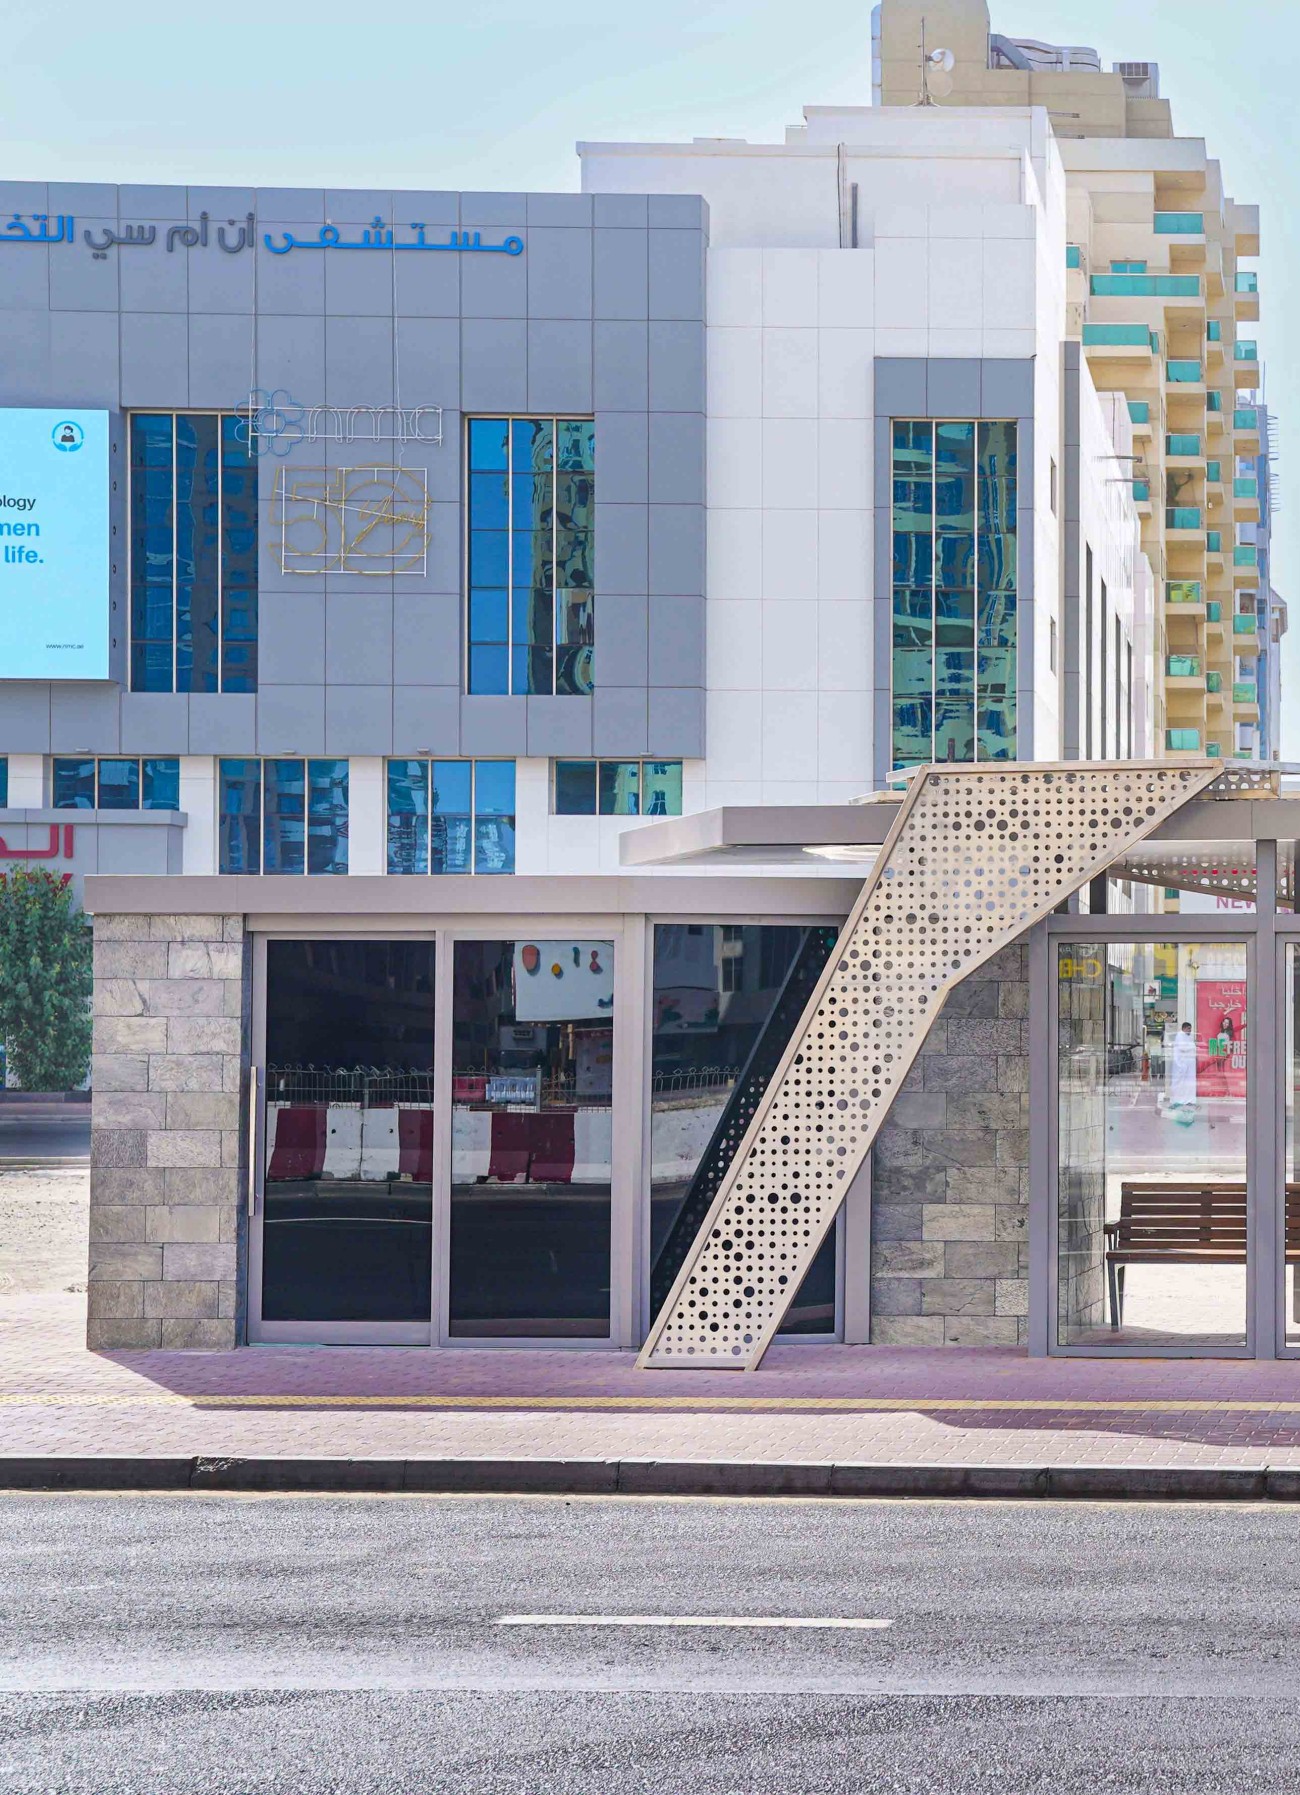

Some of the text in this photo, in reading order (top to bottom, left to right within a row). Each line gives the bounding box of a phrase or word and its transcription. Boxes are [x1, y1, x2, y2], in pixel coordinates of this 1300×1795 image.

[0, 213, 74, 243] التخ
[263, 215, 524, 256] مستشفى
[84, 225, 156, 260] سي
[309, 403, 442, 444] nmc
[0, 494, 36, 511] logy
[0, 522, 40, 537] men
[4, 545, 44, 564] life.
[1208, 1038, 1246, 1056] REFRE
